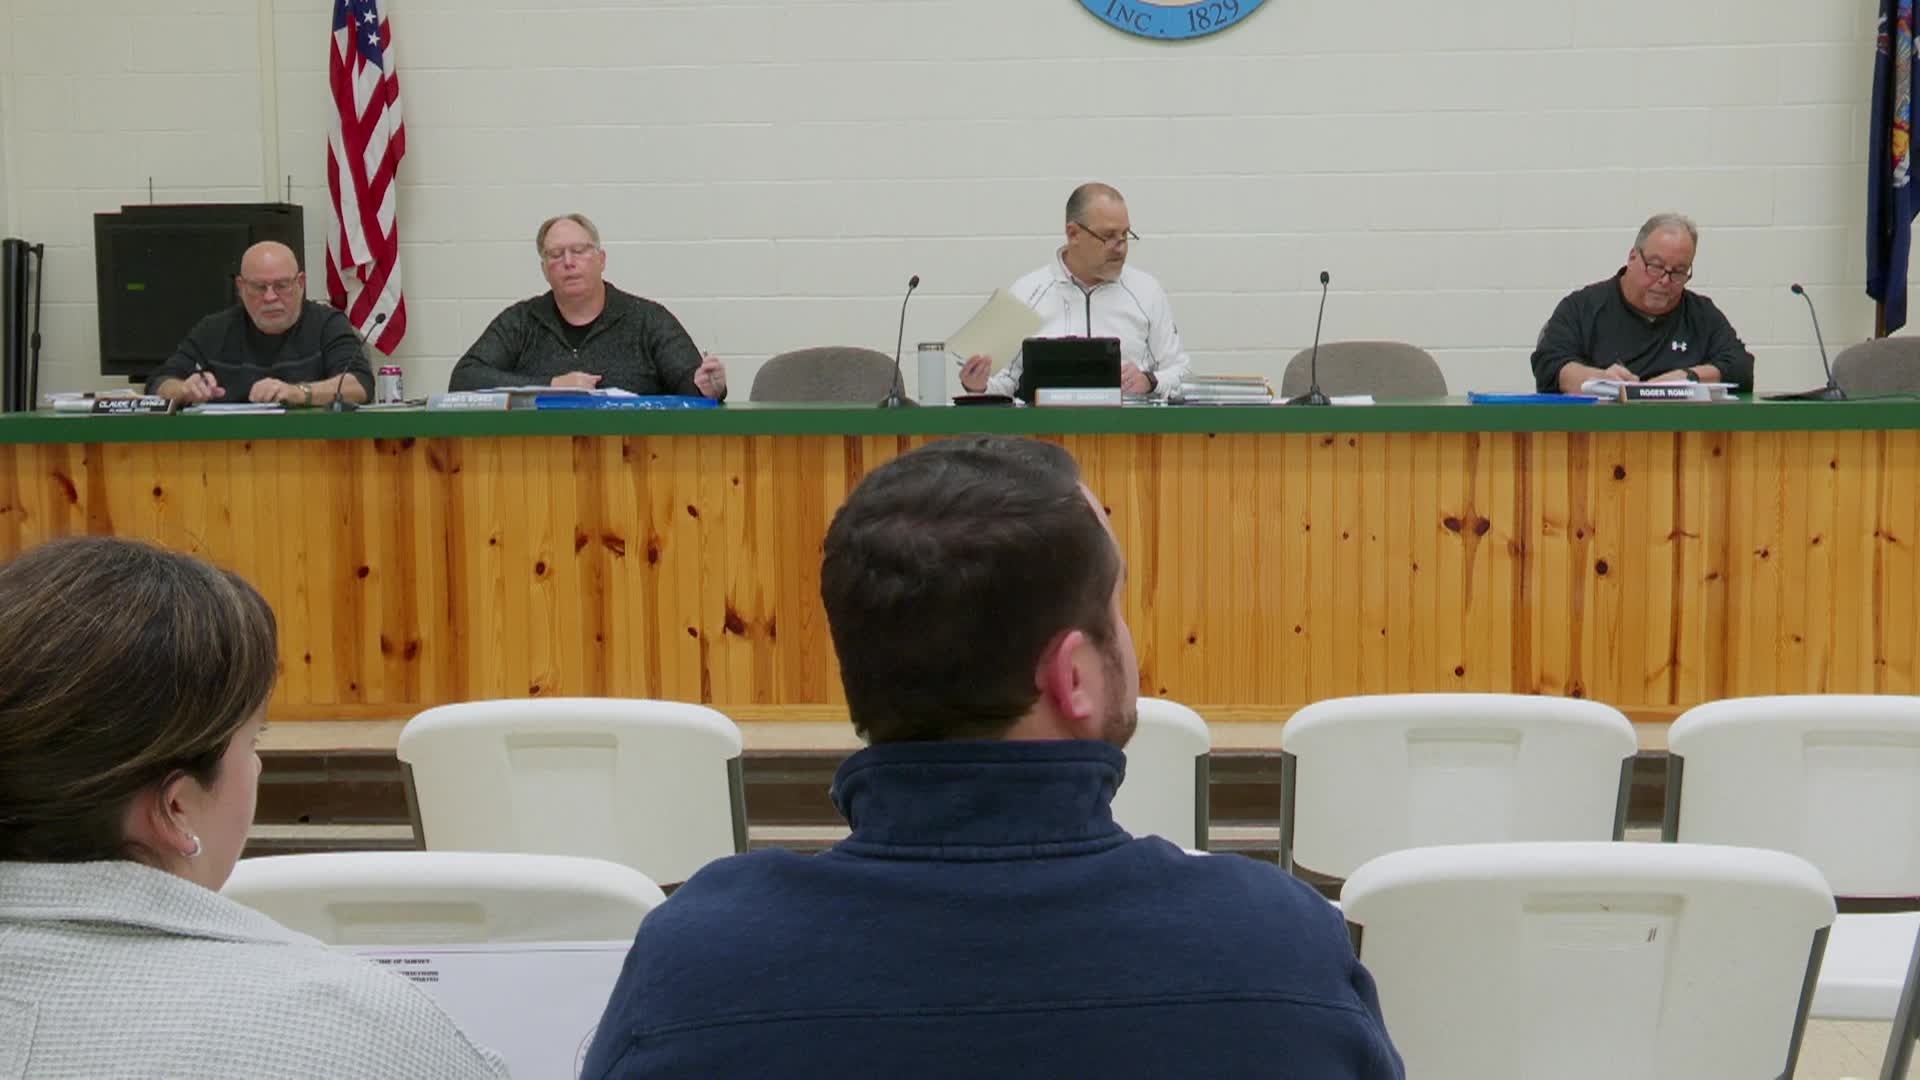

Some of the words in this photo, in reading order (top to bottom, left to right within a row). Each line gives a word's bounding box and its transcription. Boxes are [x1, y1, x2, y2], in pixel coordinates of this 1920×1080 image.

[1187, 0, 1240, 33] 1829
[1640, 388, 1666, 397] ROGER
[98, 400, 130, 409] CLAUDE
